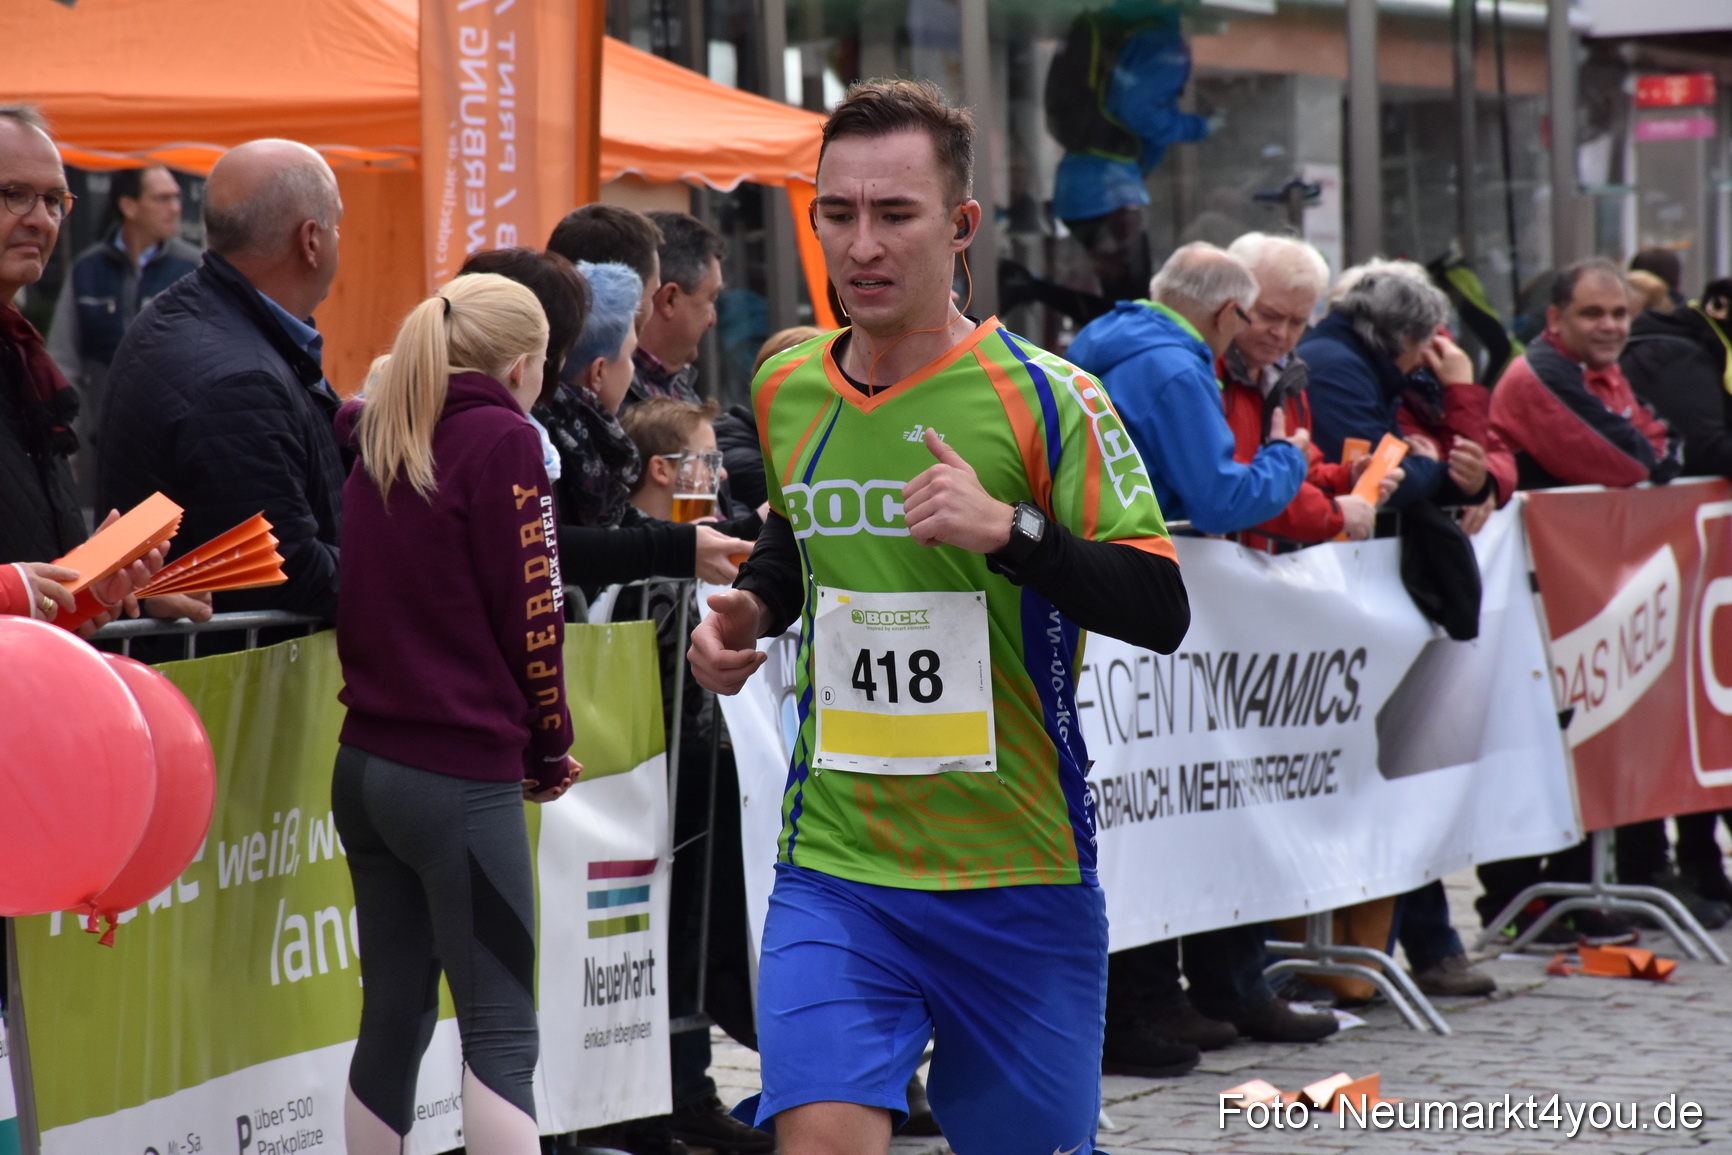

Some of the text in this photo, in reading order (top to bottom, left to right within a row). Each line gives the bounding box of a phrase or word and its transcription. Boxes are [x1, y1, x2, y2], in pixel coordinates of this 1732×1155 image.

[781, 479, 911, 540] BOC
[865, 609, 929, 625] BOCK
[825, 690, 831, 701] D
[851, 648, 944, 704] 418
[1089, 767, 1174, 830] RBRAUCH.
[218, 807, 300, 889] weiß,
[270, 898, 363, 988] lan
[255, 1108, 285, 1130] über
[287, 1096, 313, 1122] 500
[413, 1091, 463, 1122] eumark
[258, 1128, 324, 1155] Parkplätze
